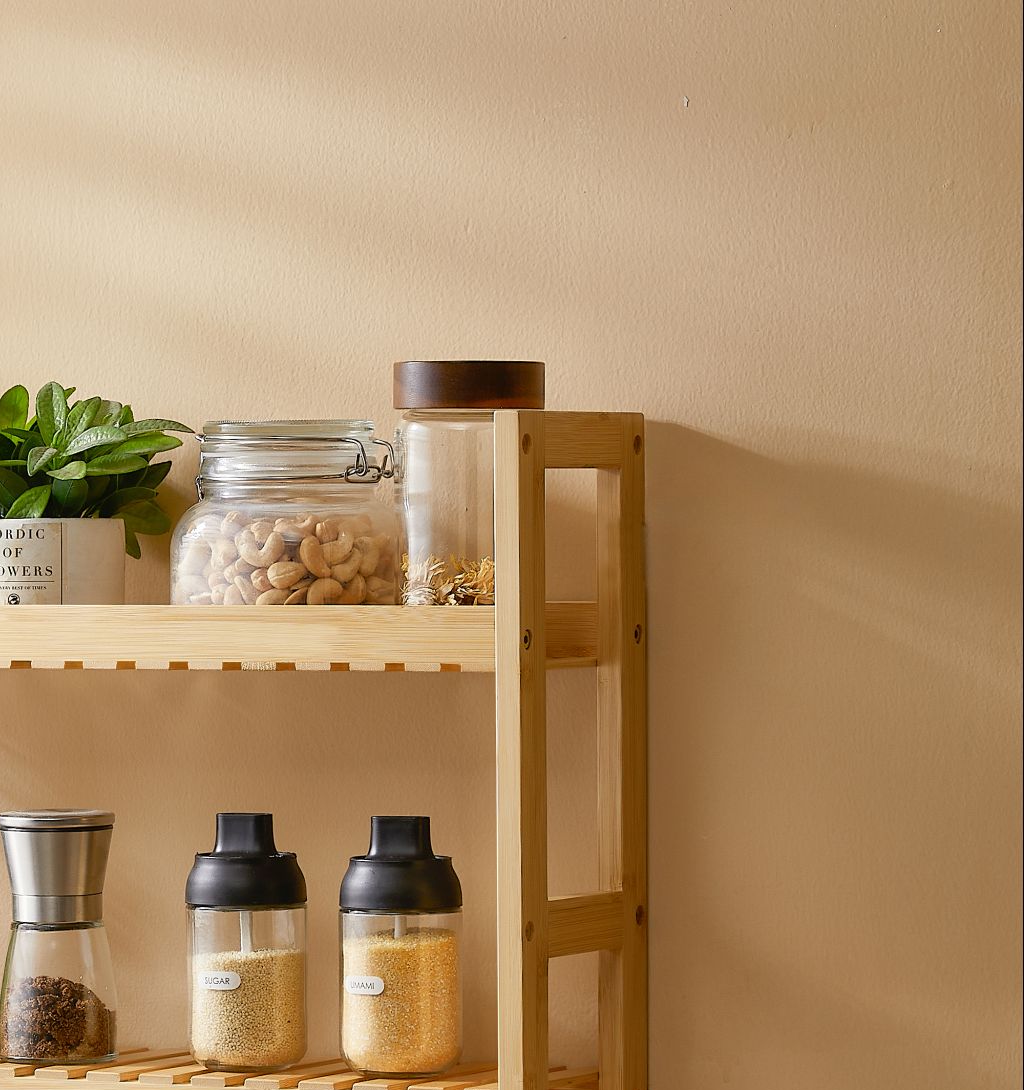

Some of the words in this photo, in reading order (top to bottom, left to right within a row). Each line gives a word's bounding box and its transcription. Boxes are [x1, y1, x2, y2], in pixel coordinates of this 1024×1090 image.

[2, 547, 23, 558] OF
[204, 976, 230, 985] SUGAR
[351, 981, 375, 990] UMAMI
